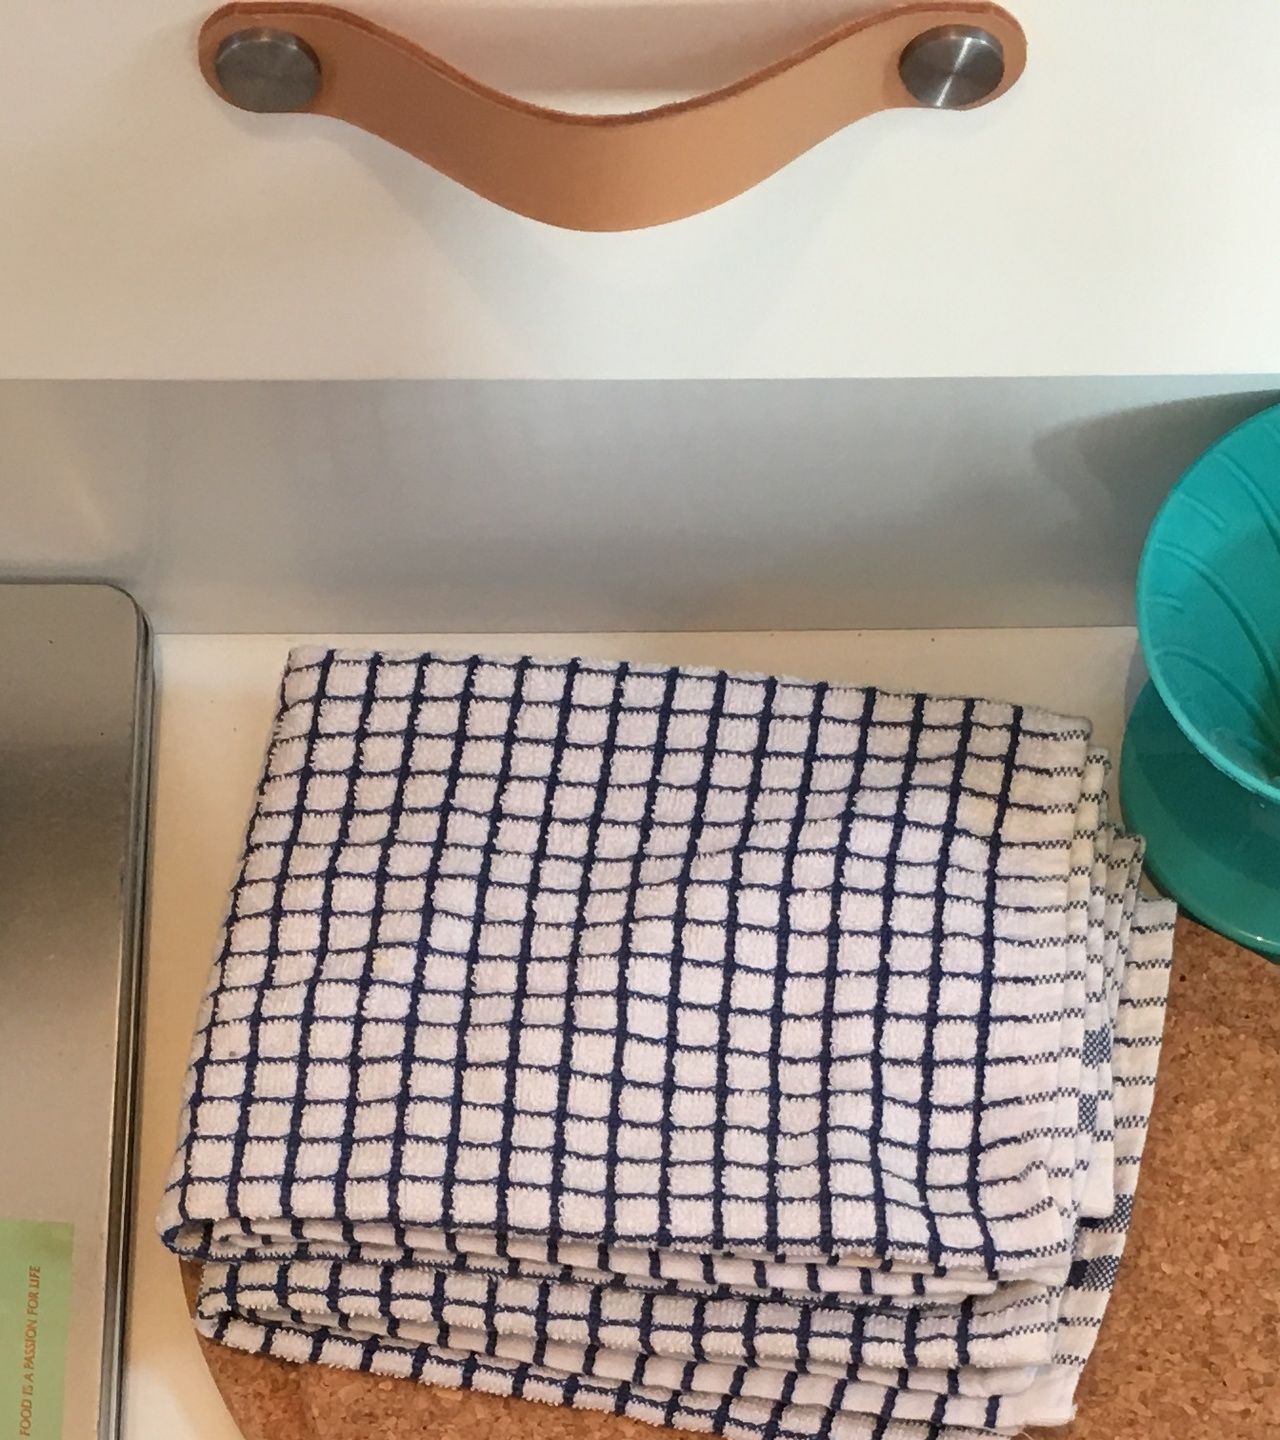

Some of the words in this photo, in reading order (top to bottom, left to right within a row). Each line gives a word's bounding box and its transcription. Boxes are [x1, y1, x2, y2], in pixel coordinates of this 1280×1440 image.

[28, 1265, 41, 1289] LIFE
[27, 1291, 39, 1316] FOR
[24, 1320, 38, 1370] PASSION
[23, 1373, 35, 1383] A
[23, 1384, 34, 1396] IS
[20, 1400, 32, 1437] FOOD
